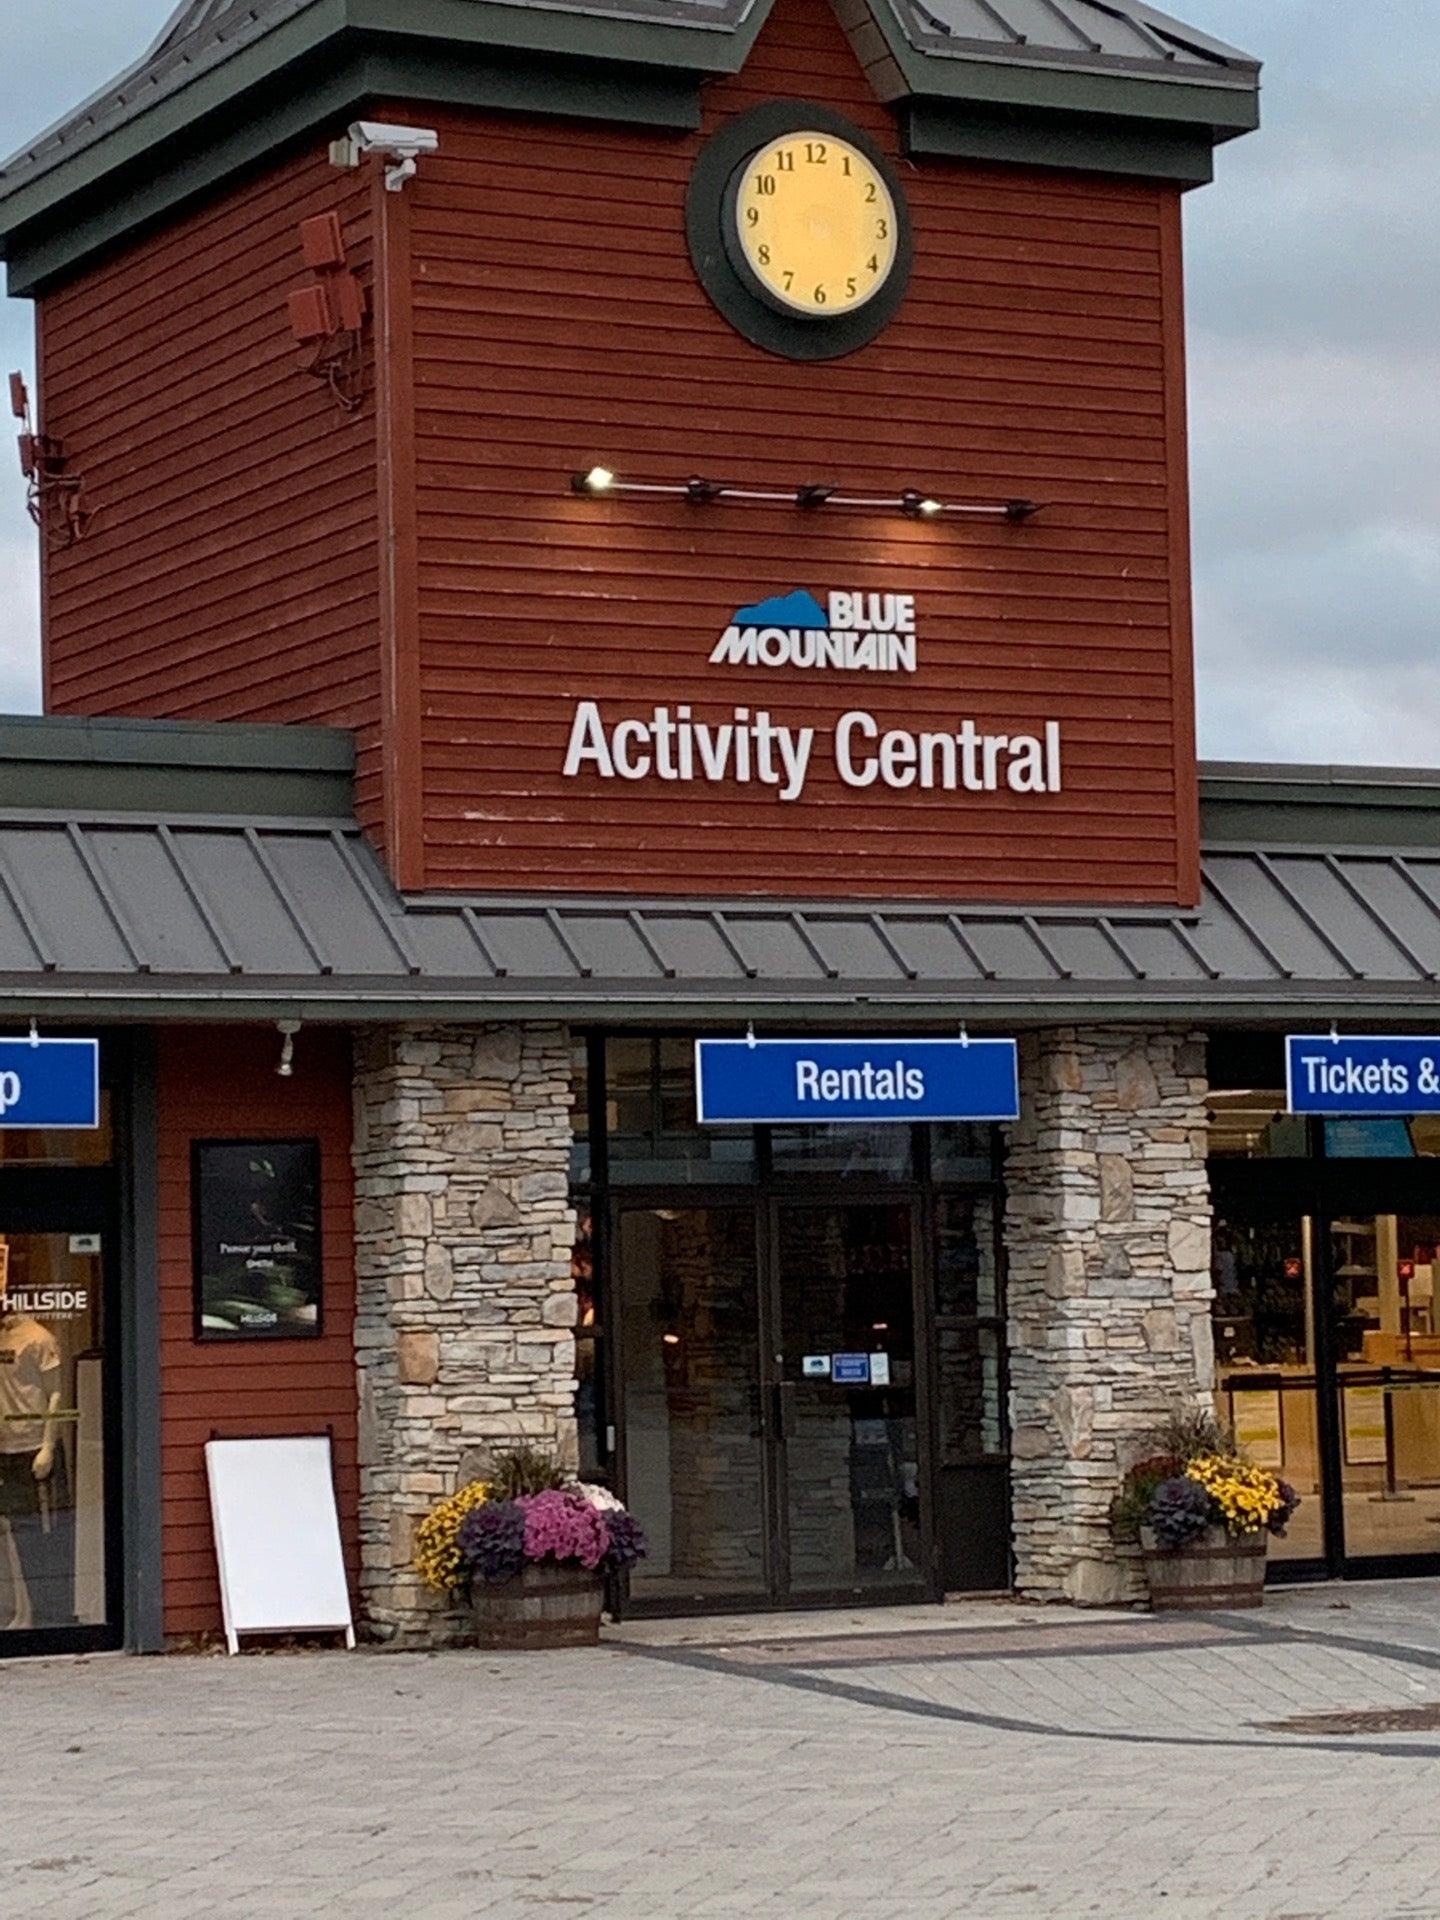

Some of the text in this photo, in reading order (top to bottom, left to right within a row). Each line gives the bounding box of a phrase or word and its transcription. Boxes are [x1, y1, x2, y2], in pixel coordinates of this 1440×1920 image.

[777, 151, 795, 172] 11
[805, 143, 827, 164] 12
[842, 156, 851, 177] 1
[755, 174, 776, 196] 10
[865, 182, 876, 203] 2
[747, 207, 759, 228] 9
[876, 219, 887, 240] 3
[758, 245, 770, 266] 8
[866, 253, 878, 274] 4
[782, 271, 794, 292] 7
[845, 277, 856, 298] 5
[814, 284, 826, 304] 6
[828, 591, 916, 632] BLUE
[708, 626, 917, 672] MOUNTAIN
[562, 701, 1062, 800] Activity Central
[796, 1060, 925, 1101] Rentals
[1301, 1056, 1440, 1094] Tickets &
[2, 1290, 88, 1311] HILLSIDE
